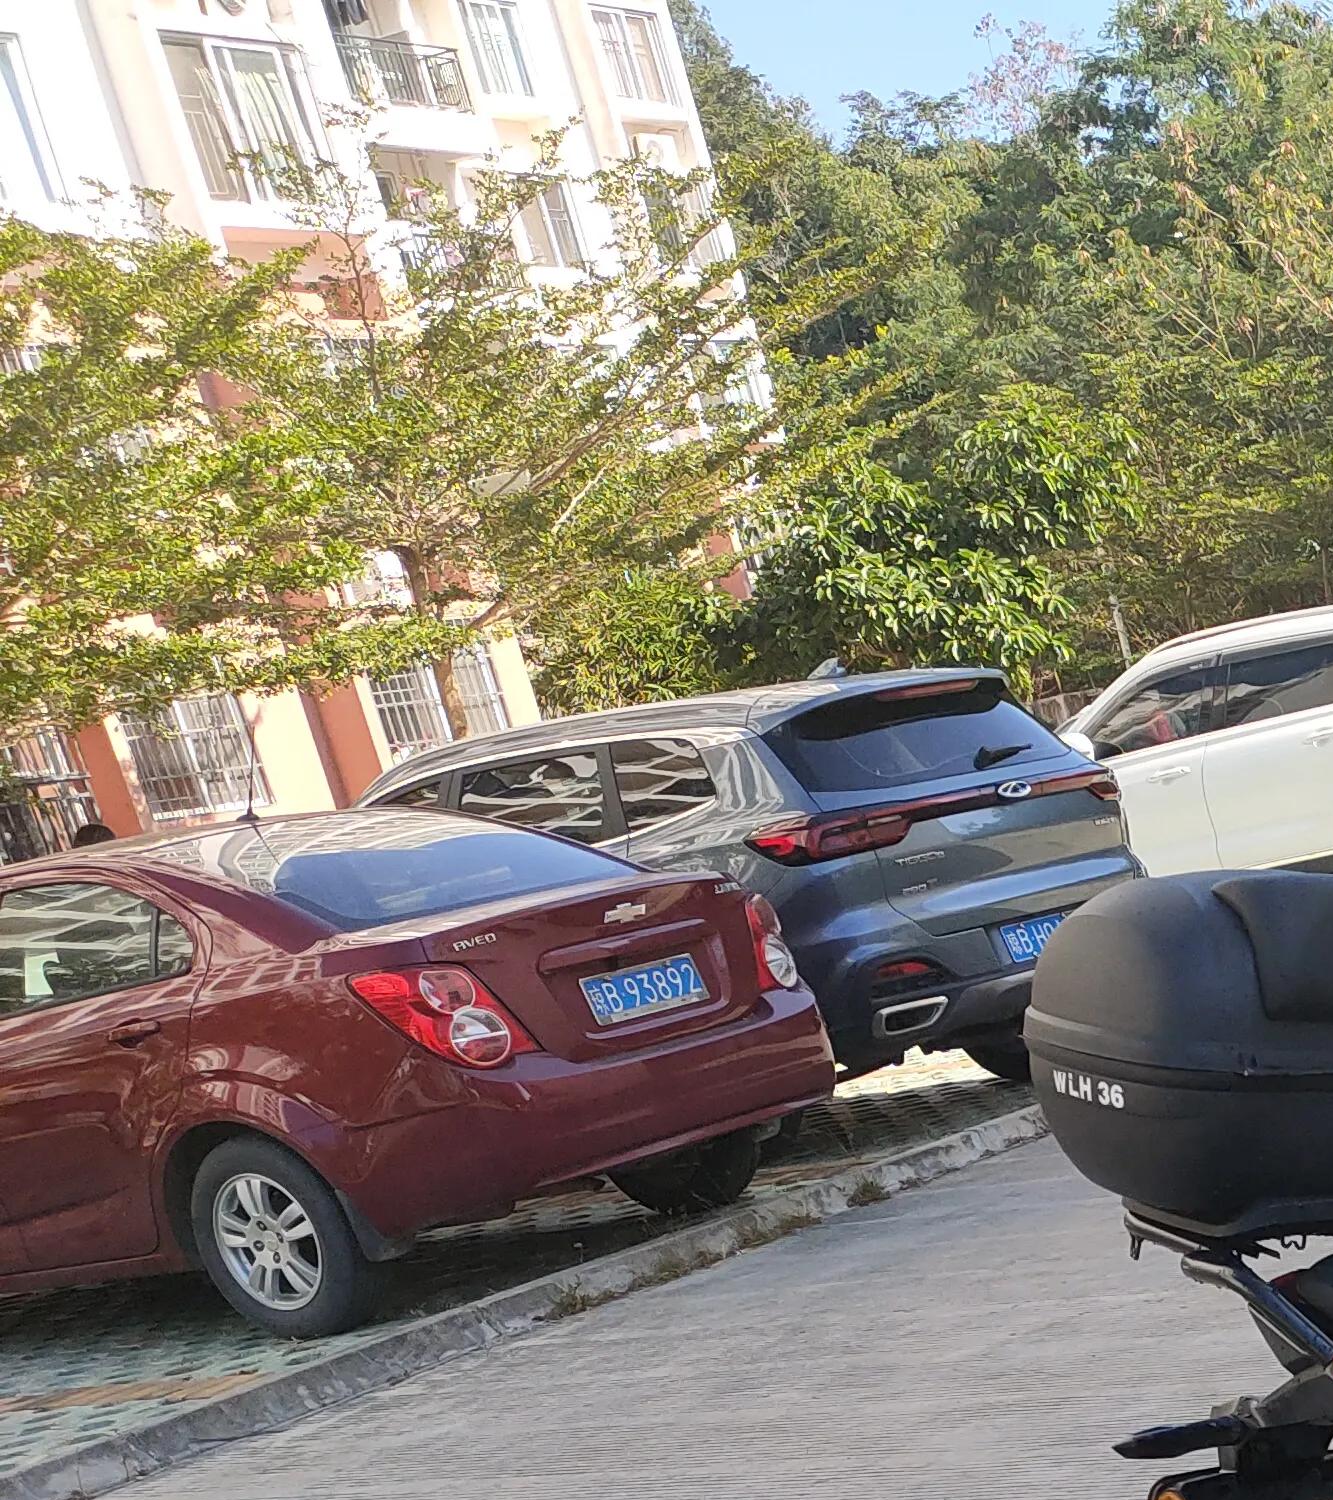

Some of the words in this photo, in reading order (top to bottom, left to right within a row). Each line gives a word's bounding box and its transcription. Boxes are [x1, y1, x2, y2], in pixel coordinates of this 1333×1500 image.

[452, 932, 497, 952] AVEO
[1053, 1069, 1093, 1102] WLH
[1097, 1081, 1125, 1109] 36
